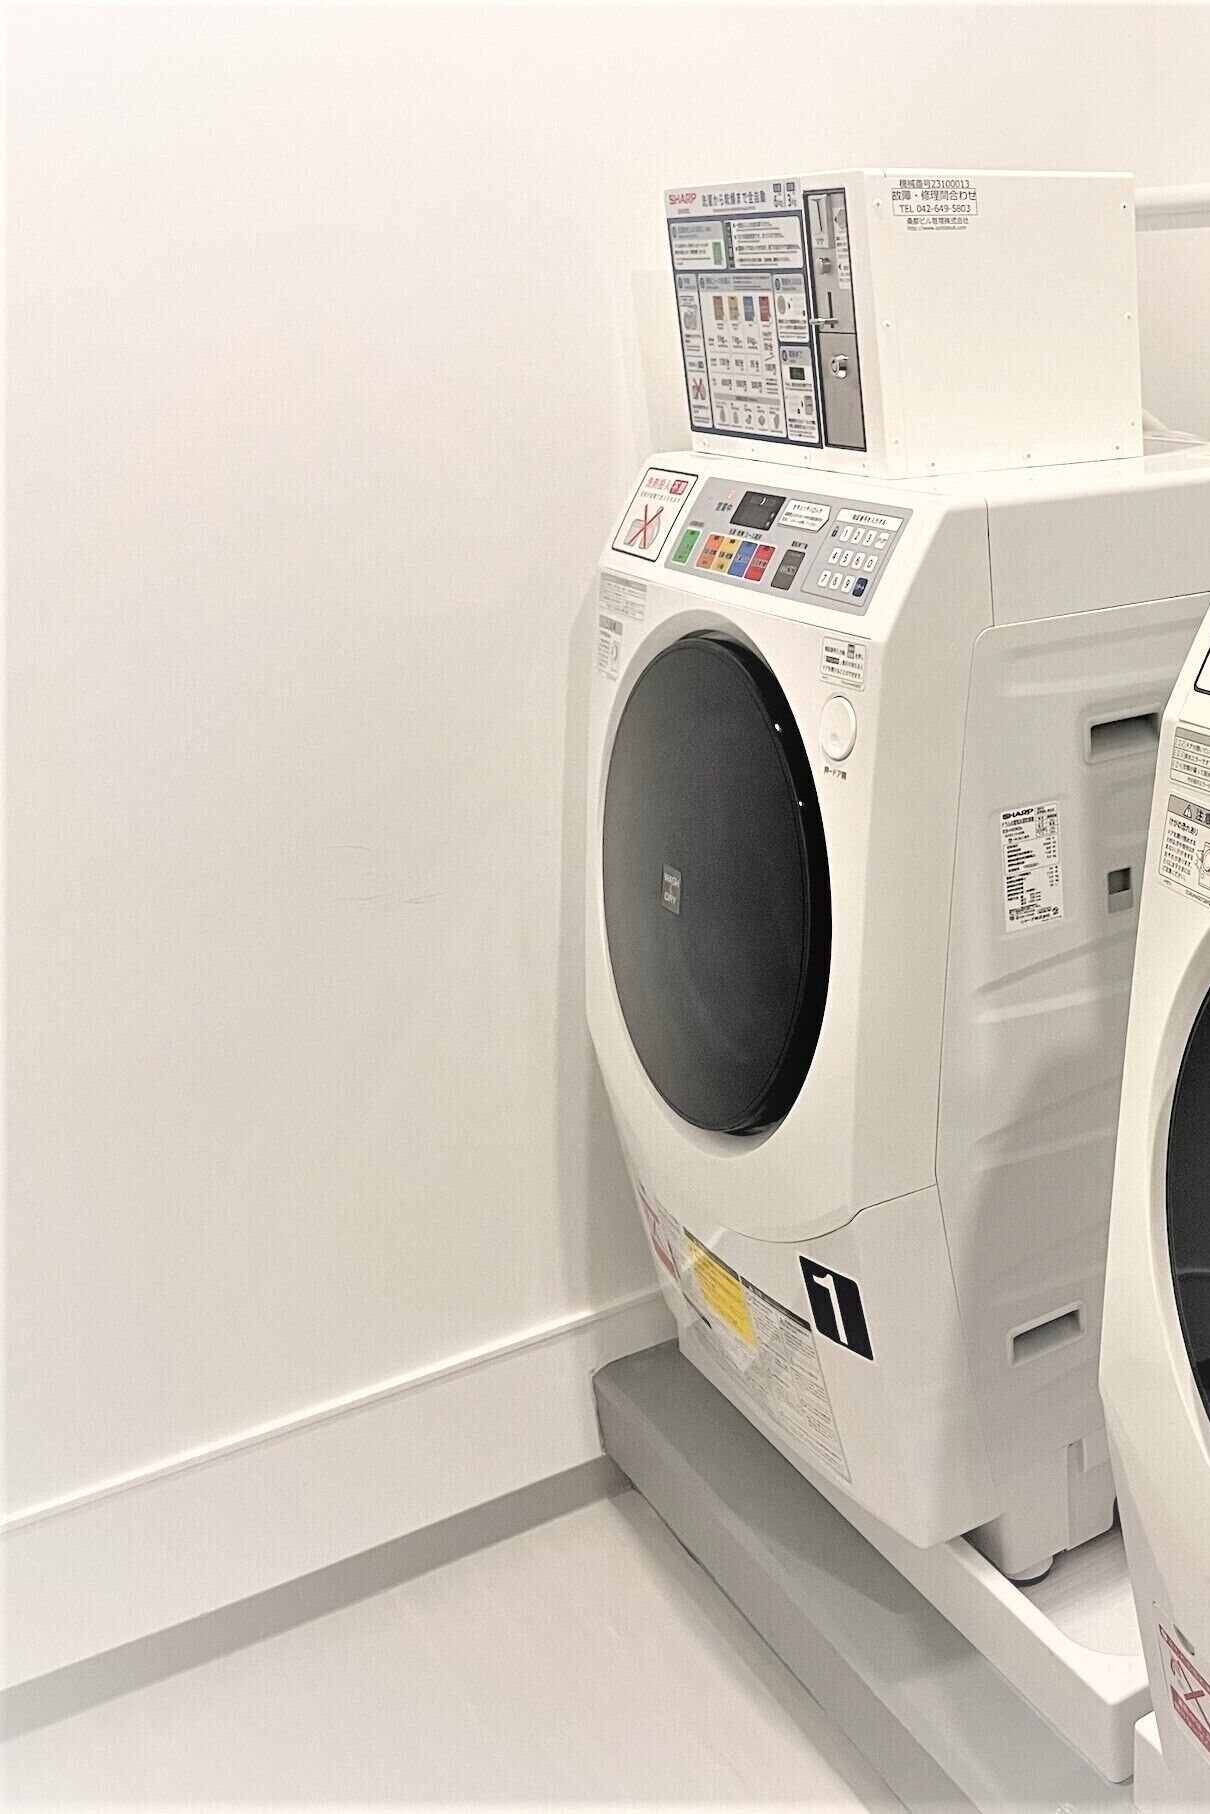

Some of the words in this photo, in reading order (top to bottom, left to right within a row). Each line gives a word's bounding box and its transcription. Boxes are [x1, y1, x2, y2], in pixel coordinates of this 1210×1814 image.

[669, 193, 697, 205] SHARP
[892, 190, 977, 201] 故障・修理問合わせ
[899, 204, 914, 213] TEL
[916, 204, 971, 213] 042-649-5803
[1002, 808, 1034, 820] SHARP
[812, 1273, 848, 1346] 1
